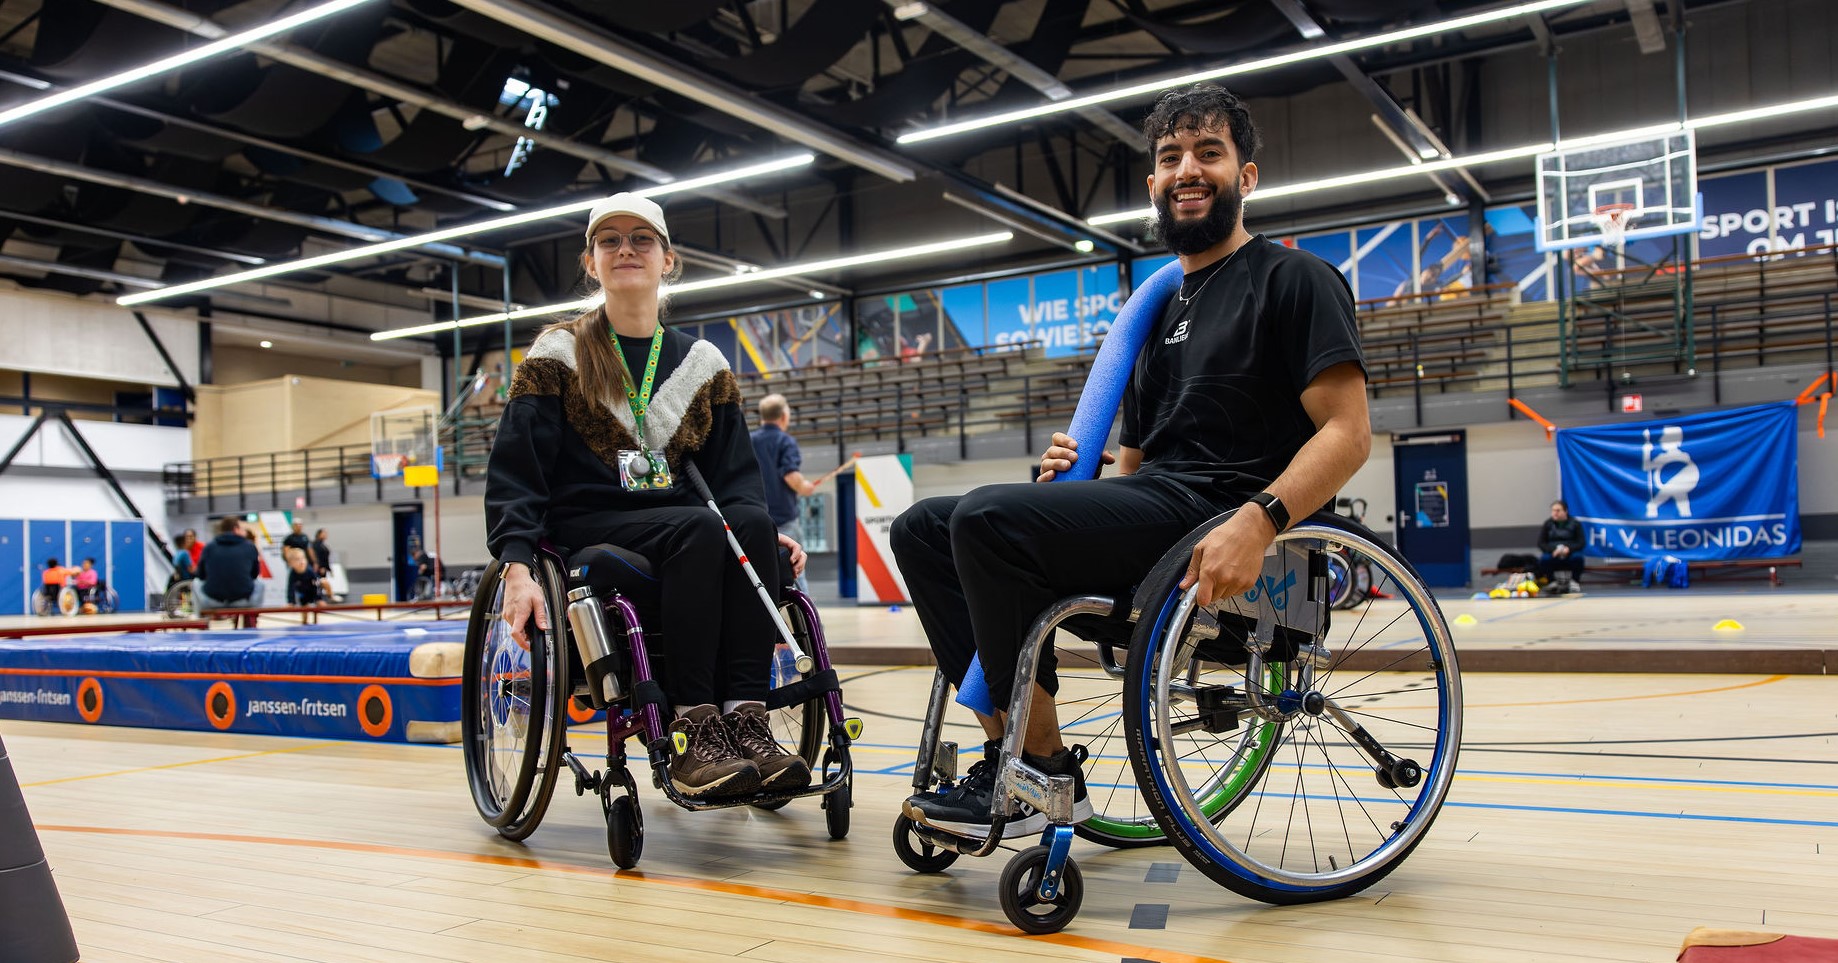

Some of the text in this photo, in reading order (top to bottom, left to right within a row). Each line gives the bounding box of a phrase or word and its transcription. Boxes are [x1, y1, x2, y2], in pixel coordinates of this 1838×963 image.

[1700, 199, 1838, 240] SPORT I
[1746, 232, 1806, 262] OM
[1018, 299, 1068, 325] WIE
[1651, 523, 1787, 550] LEONIDAS
[1136, 728, 1192, 848] MARATHON PLUS
